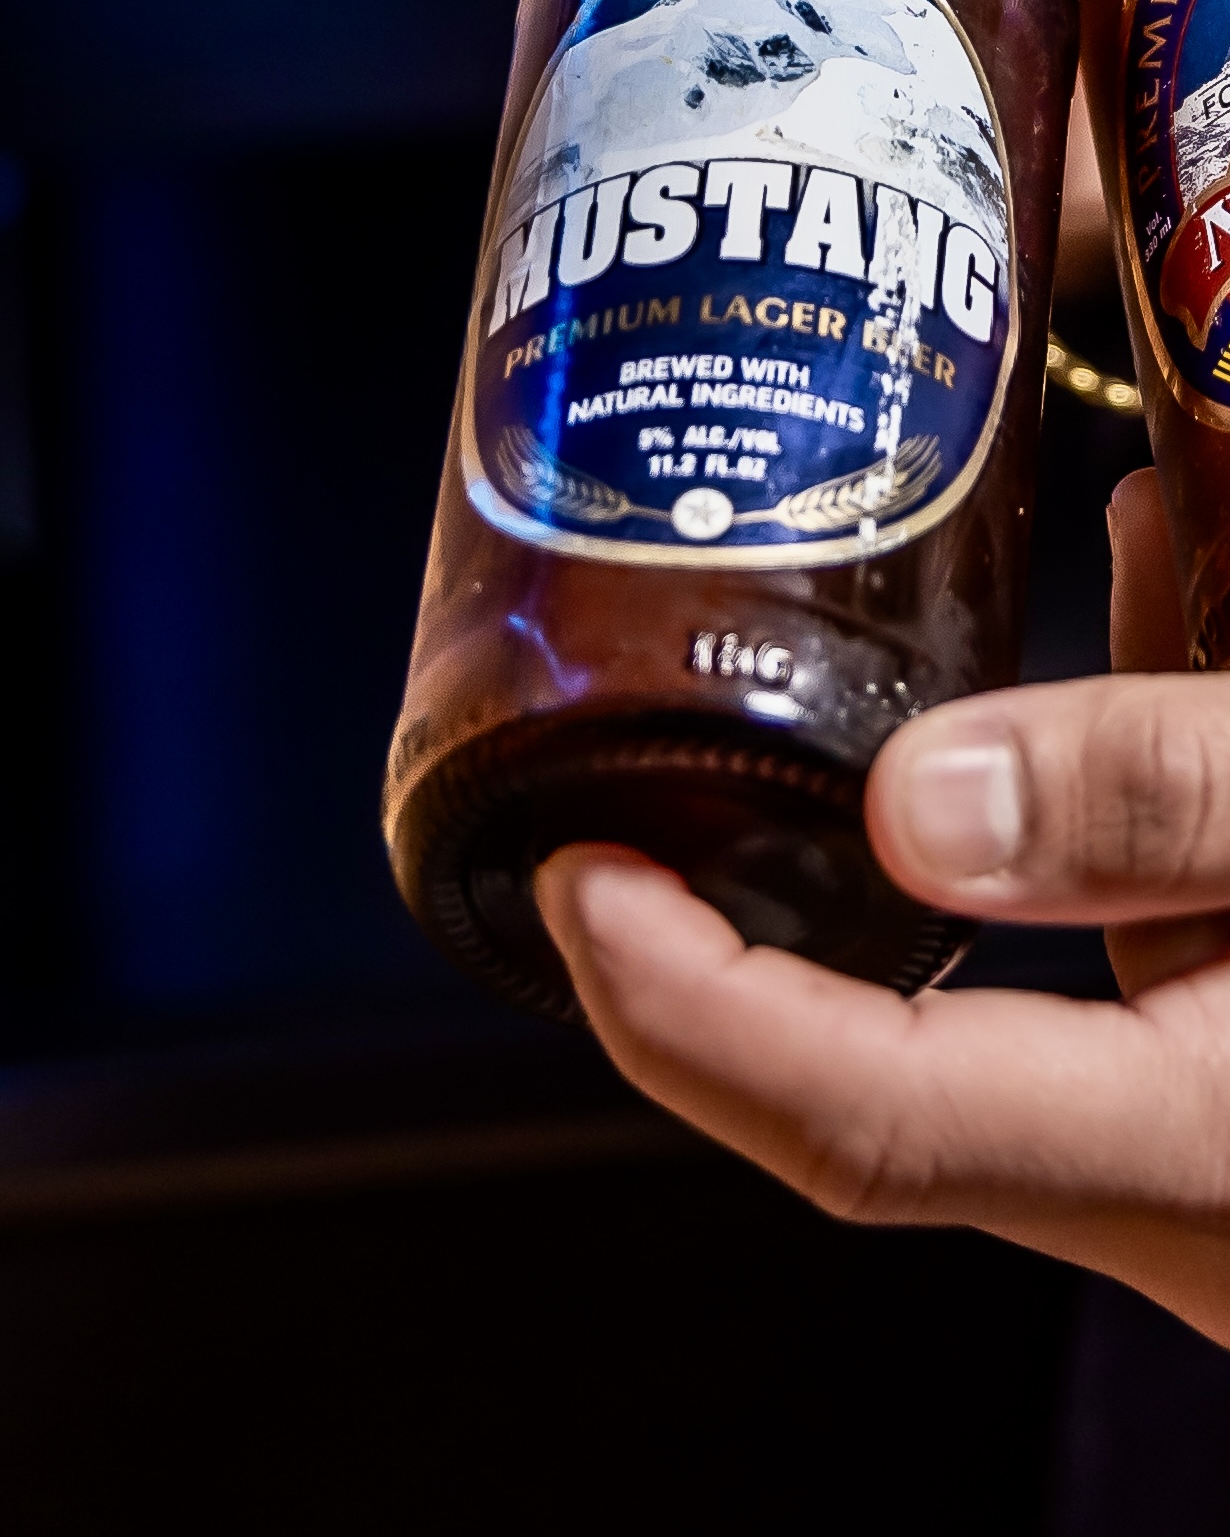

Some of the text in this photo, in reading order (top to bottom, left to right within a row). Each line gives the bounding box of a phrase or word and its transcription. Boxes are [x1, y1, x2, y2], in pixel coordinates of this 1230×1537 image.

[486, 158, 999, 345] MUSTANG
[503, 295, 682, 380] PREMIUM
[700, 294, 847, 342] LAGER
[619, 353, 811, 389] BREWED WITH
[566, 380, 866, 434] NATURAL INGREDIENTS
